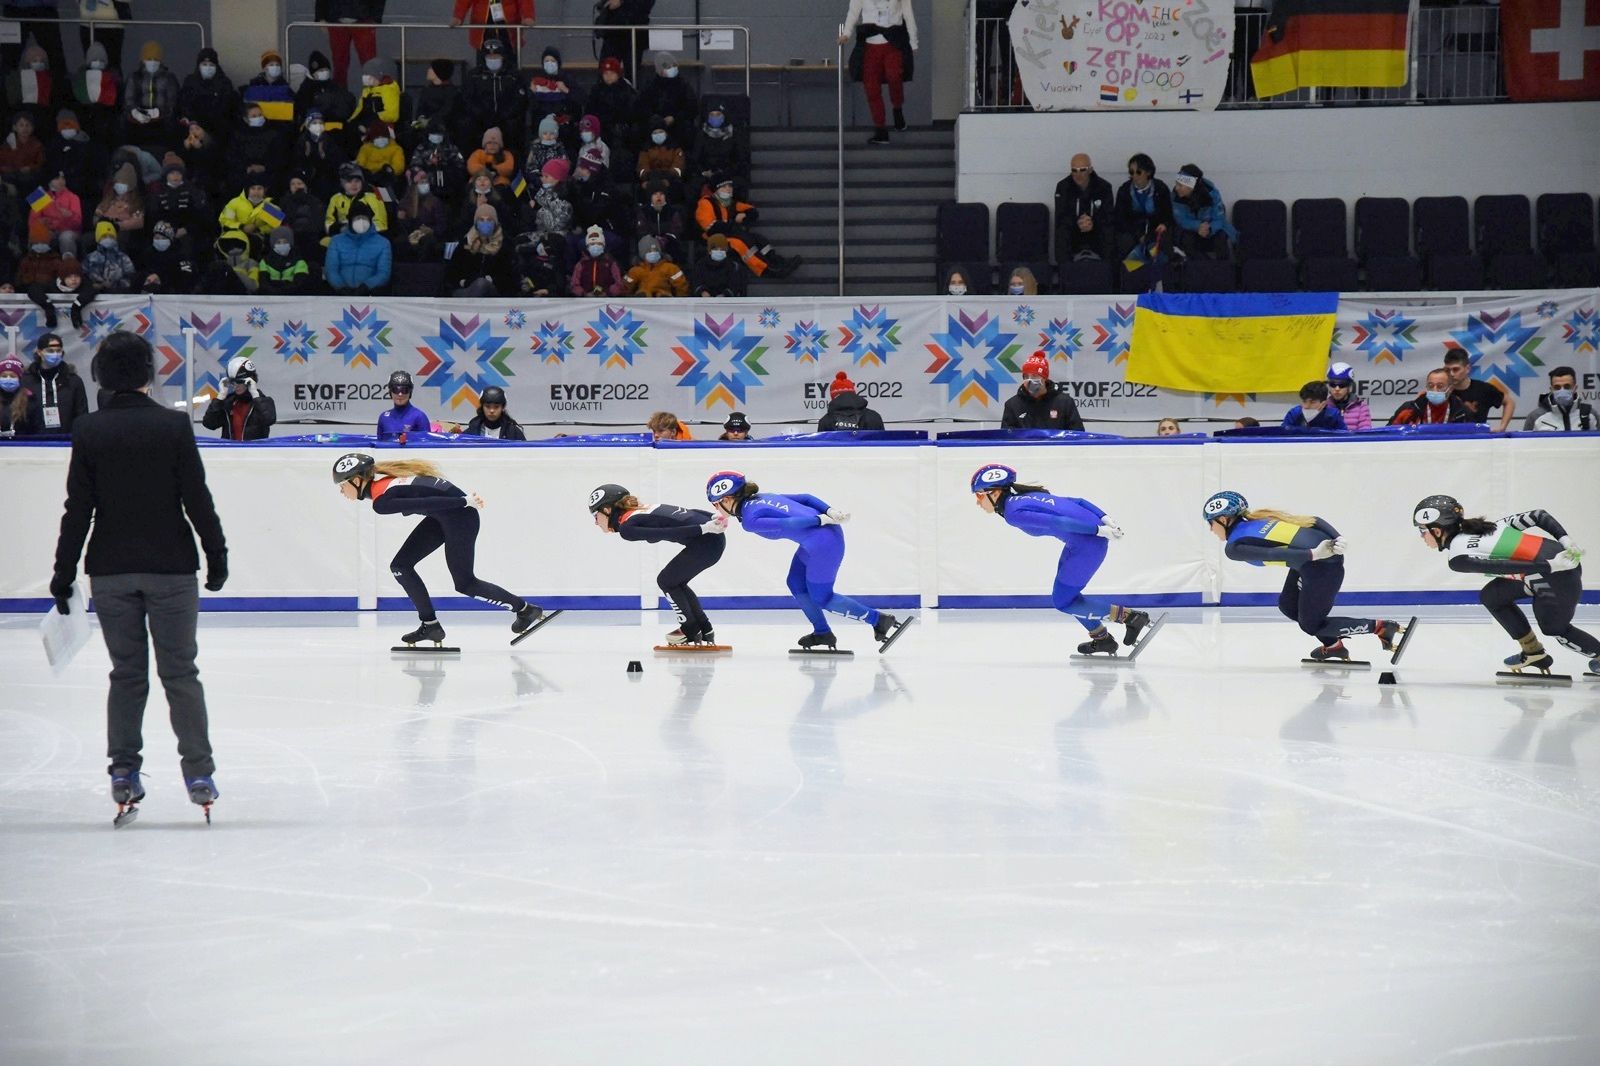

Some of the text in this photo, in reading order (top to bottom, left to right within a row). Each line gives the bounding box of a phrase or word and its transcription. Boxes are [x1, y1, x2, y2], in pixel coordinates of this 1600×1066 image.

[294, 384, 391, 400] EYOF2022
[550, 384, 649, 400] EYOF2022
[804, 382, 902, 398] EY2022
[293, 401, 347, 411] VUOKATTI
[549, 401, 602, 411] VUOKATTI
[339, 458, 353, 470] 34
[988, 471, 1002, 480] 25
[714, 481, 728, 493] 26
[744, 499, 790, 513] ITALIA
[1008, 496, 1056, 506] ITALIA
[1209, 500, 1223, 512] 58
[1422, 511, 1430, 521] 4
